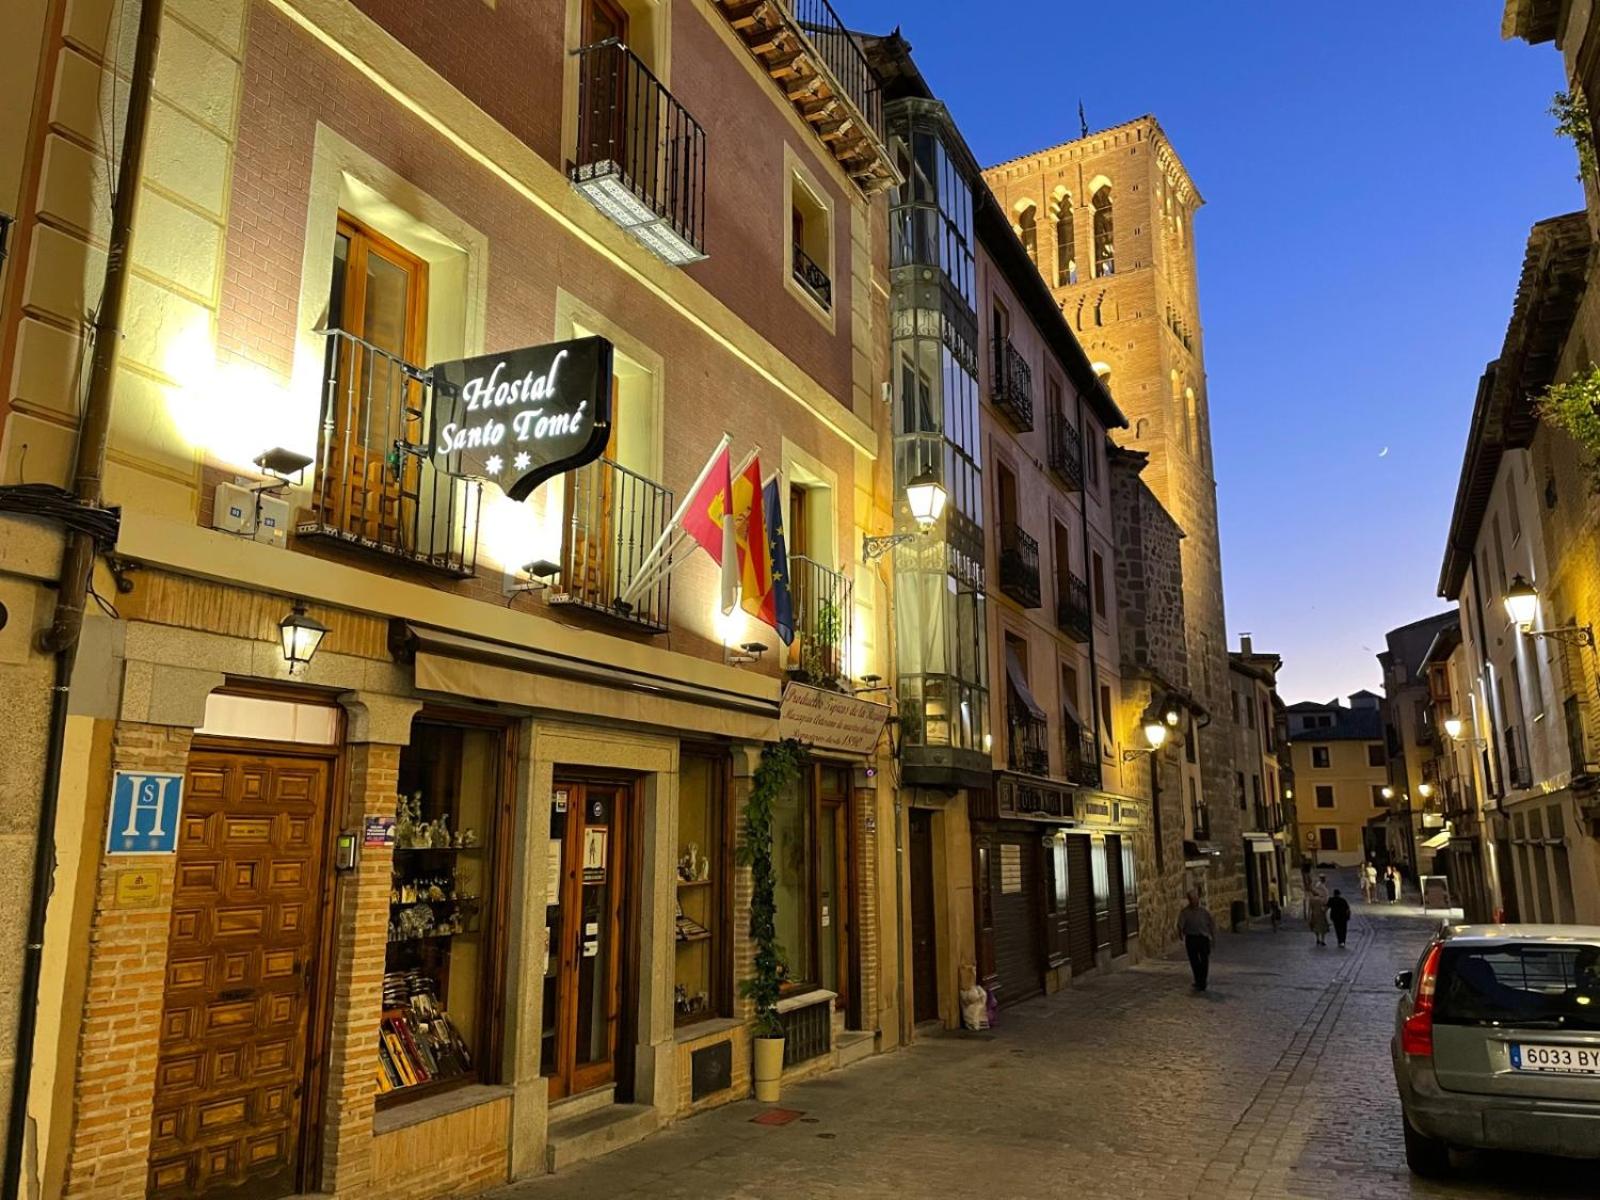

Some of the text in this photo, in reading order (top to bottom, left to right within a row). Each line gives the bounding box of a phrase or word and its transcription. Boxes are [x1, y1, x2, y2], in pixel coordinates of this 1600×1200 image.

[462, 350, 568, 411] Hostal
[438, 400, 588, 454] Santo Tomé
[1527, 1048, 1599, 1067] 6033 BY
